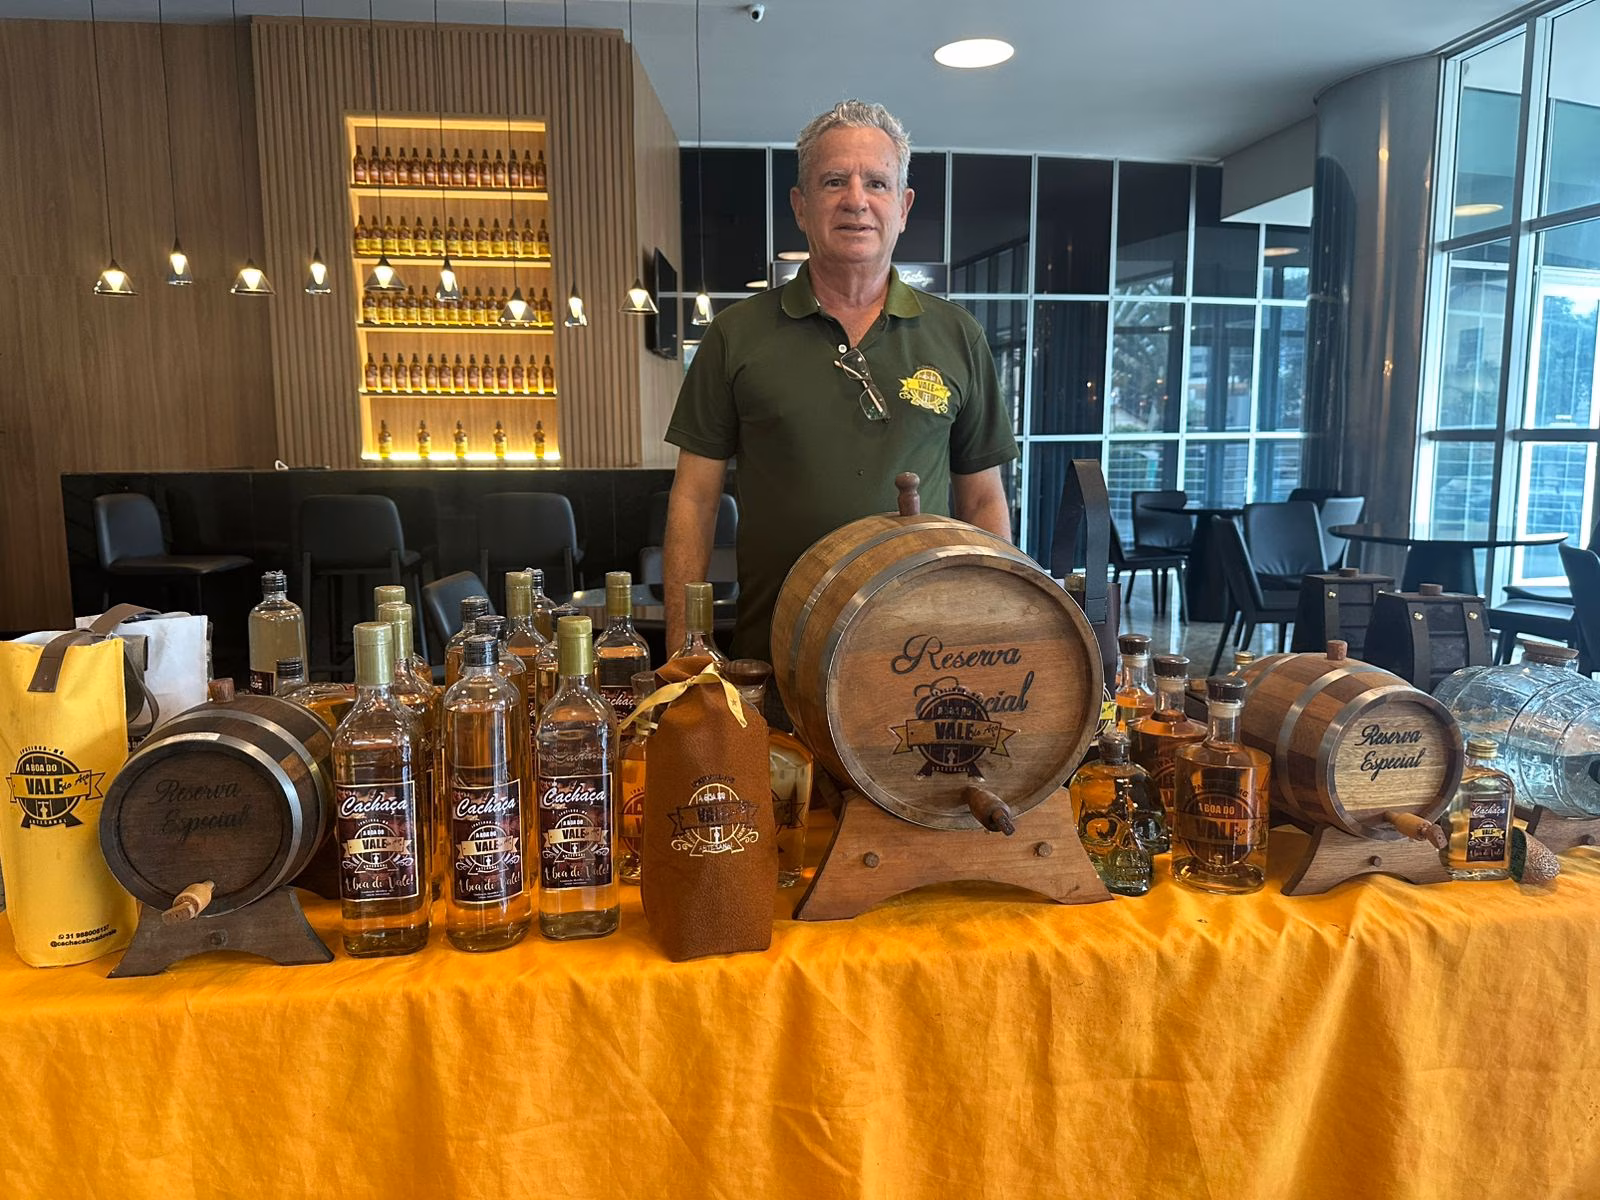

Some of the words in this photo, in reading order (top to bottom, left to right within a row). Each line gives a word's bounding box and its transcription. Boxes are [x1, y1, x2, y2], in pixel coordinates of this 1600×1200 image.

[890, 634, 1022, 675] Reserva
[913, 670, 1035, 719] Ecial
[934, 722, 974, 741] VALE
[1354, 724, 1423, 746] Reserva
[25, 764, 30, 772] A
[31, 763, 45, 772] BOA
[46, 763, 58, 772] DO
[1360, 747, 1427, 781] Especial
[25, 777, 65, 795] VALE
[62, 782, 73, 791] do
[74, 773, 90, 786] Aço
[147, 779, 241, 805] Reserva
[341, 794, 409, 815] Cachaça
[543, 785, 607, 806] Cachaça
[456, 796, 516, 817] Cachaça
[1204, 803, 1222, 814] BOA
[1223, 805, 1235, 815] DO
[161, 803, 251, 842] Especial
[361, 838, 388, 850] VALE
[562, 828, 586, 840] VALE
[475, 840, 499, 853] VALE
